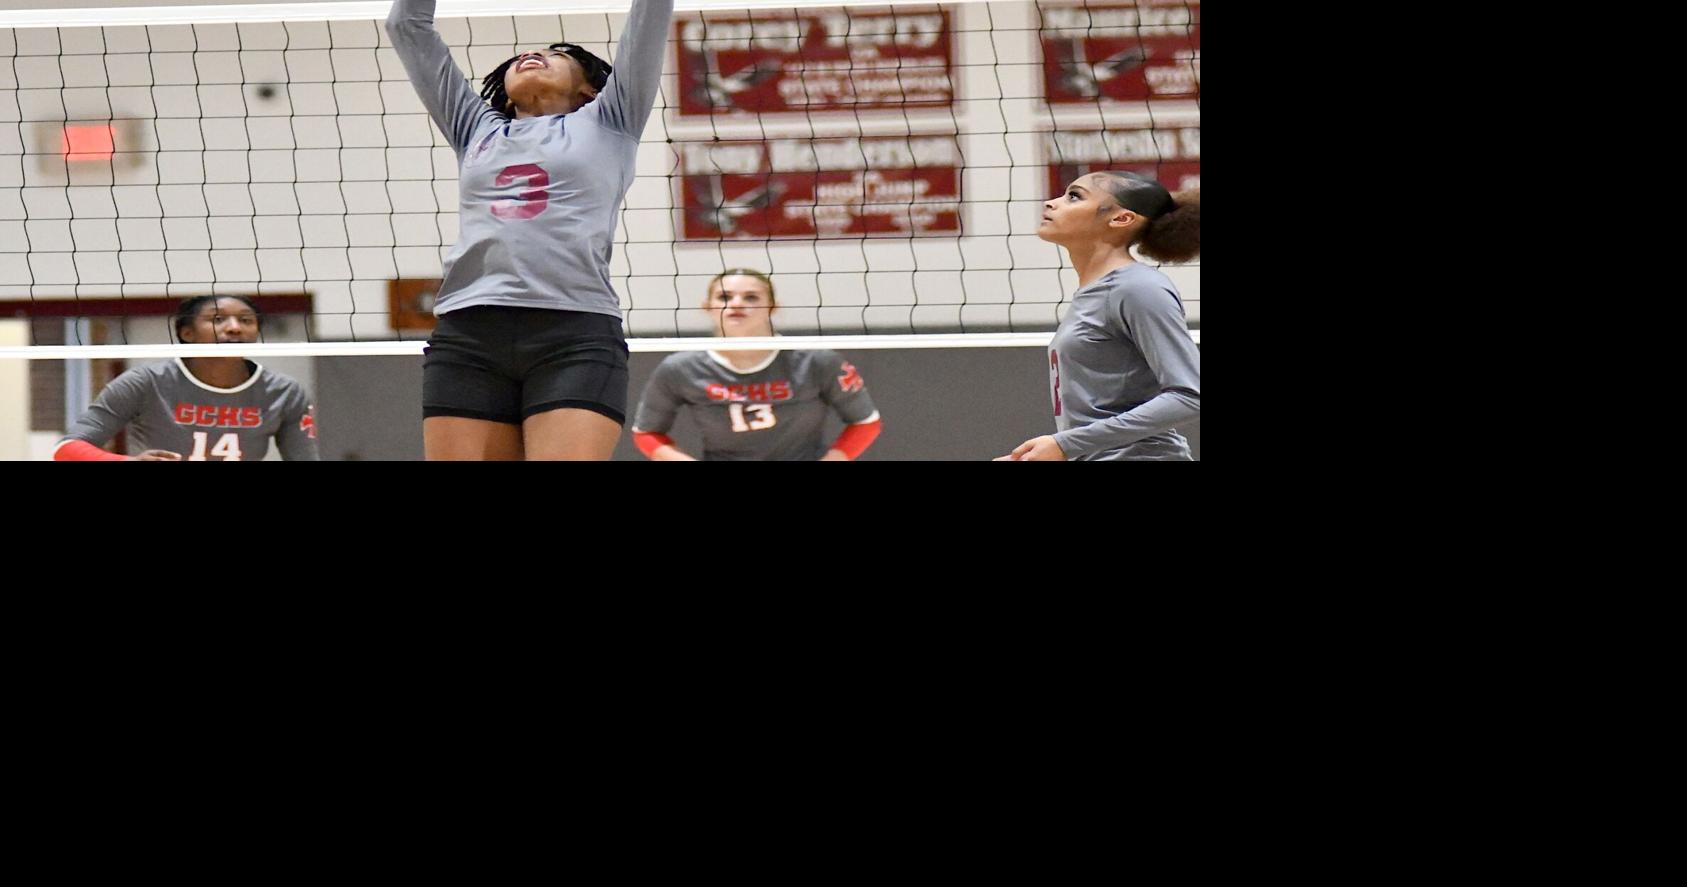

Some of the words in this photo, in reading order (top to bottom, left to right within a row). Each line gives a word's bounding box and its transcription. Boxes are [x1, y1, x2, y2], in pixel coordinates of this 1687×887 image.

[489, 163, 550, 220] 3
[706, 380, 793, 402] GCHS
[173, 403, 262, 428] GCHS
[729, 403, 777, 432] 13
[188, 431, 242, 461] 14
